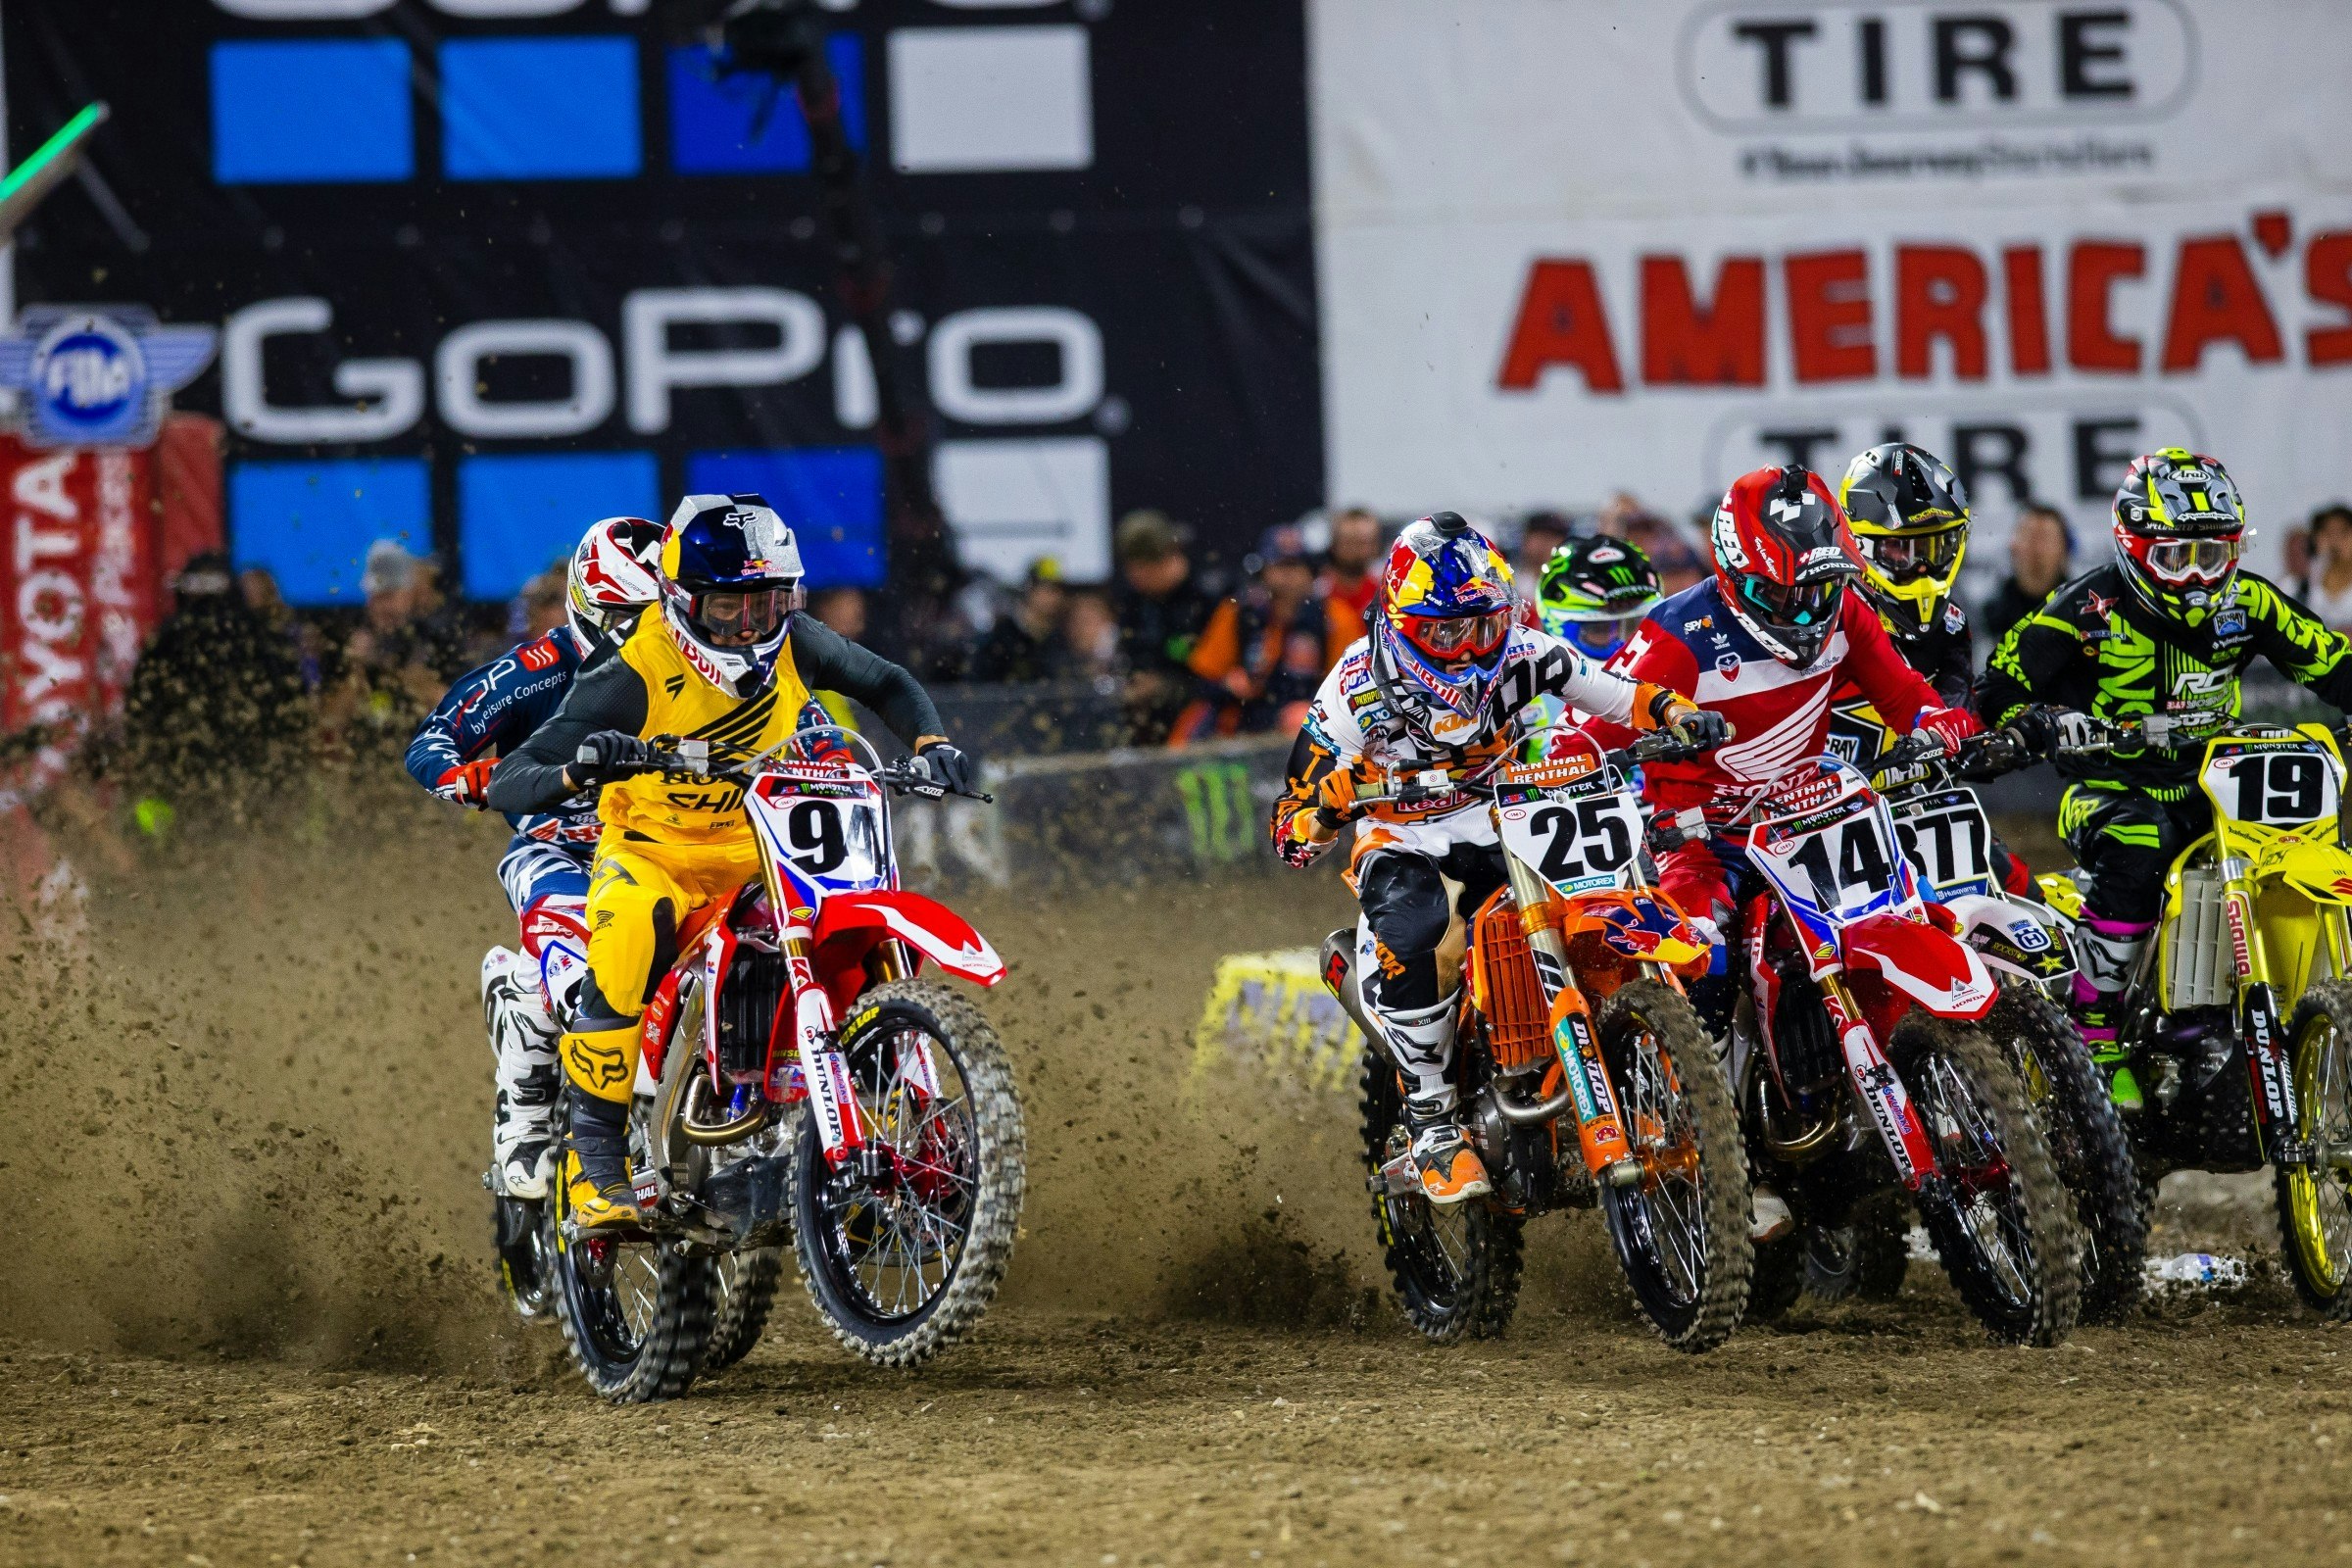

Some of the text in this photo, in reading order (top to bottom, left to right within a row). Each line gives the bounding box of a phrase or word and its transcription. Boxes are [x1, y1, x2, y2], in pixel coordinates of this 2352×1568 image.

[1735, 12, 2138, 108] TIRE
[1495, 208, 2352, 394] AMERICA'S
[220, 286, 1107, 443] GoPro
[1752, 416, 2146, 502] TRE
[2177, 470, 2203, 479] Arai
[1807, 562, 1860, 575] HONDA
[1810, 546, 1840, 562] RED
[1425, 593, 1444, 607] Airoh
[1684, 619, 1702, 632] SPY
[470, 719, 486, 735] by
[514, 669, 567, 700] Concepts
[1420, 667, 1461, 708] Bull
[809, 782, 853, 794] MONSTER
[1513, 764, 1592, 785] RENTHAL
[2229, 755, 2325, 821] 19
[1529, 796, 1634, 885] 25
[1801, 806, 1846, 826] MONSTER
[1573, 875, 1615, 890] MOTOREX
[1788, 816, 1896, 915] 14
[2226, 899, 2253, 977] SHOWA
[1951, 994, 1986, 1010] HONDA
[810, 1050, 843, 1143] DUNLOP
[1563, 1049, 1594, 1120] MOTOREX
[2251, 1008, 2283, 1120] DUNLOP
[1864, 1085, 1912, 1169] DUNLOP
